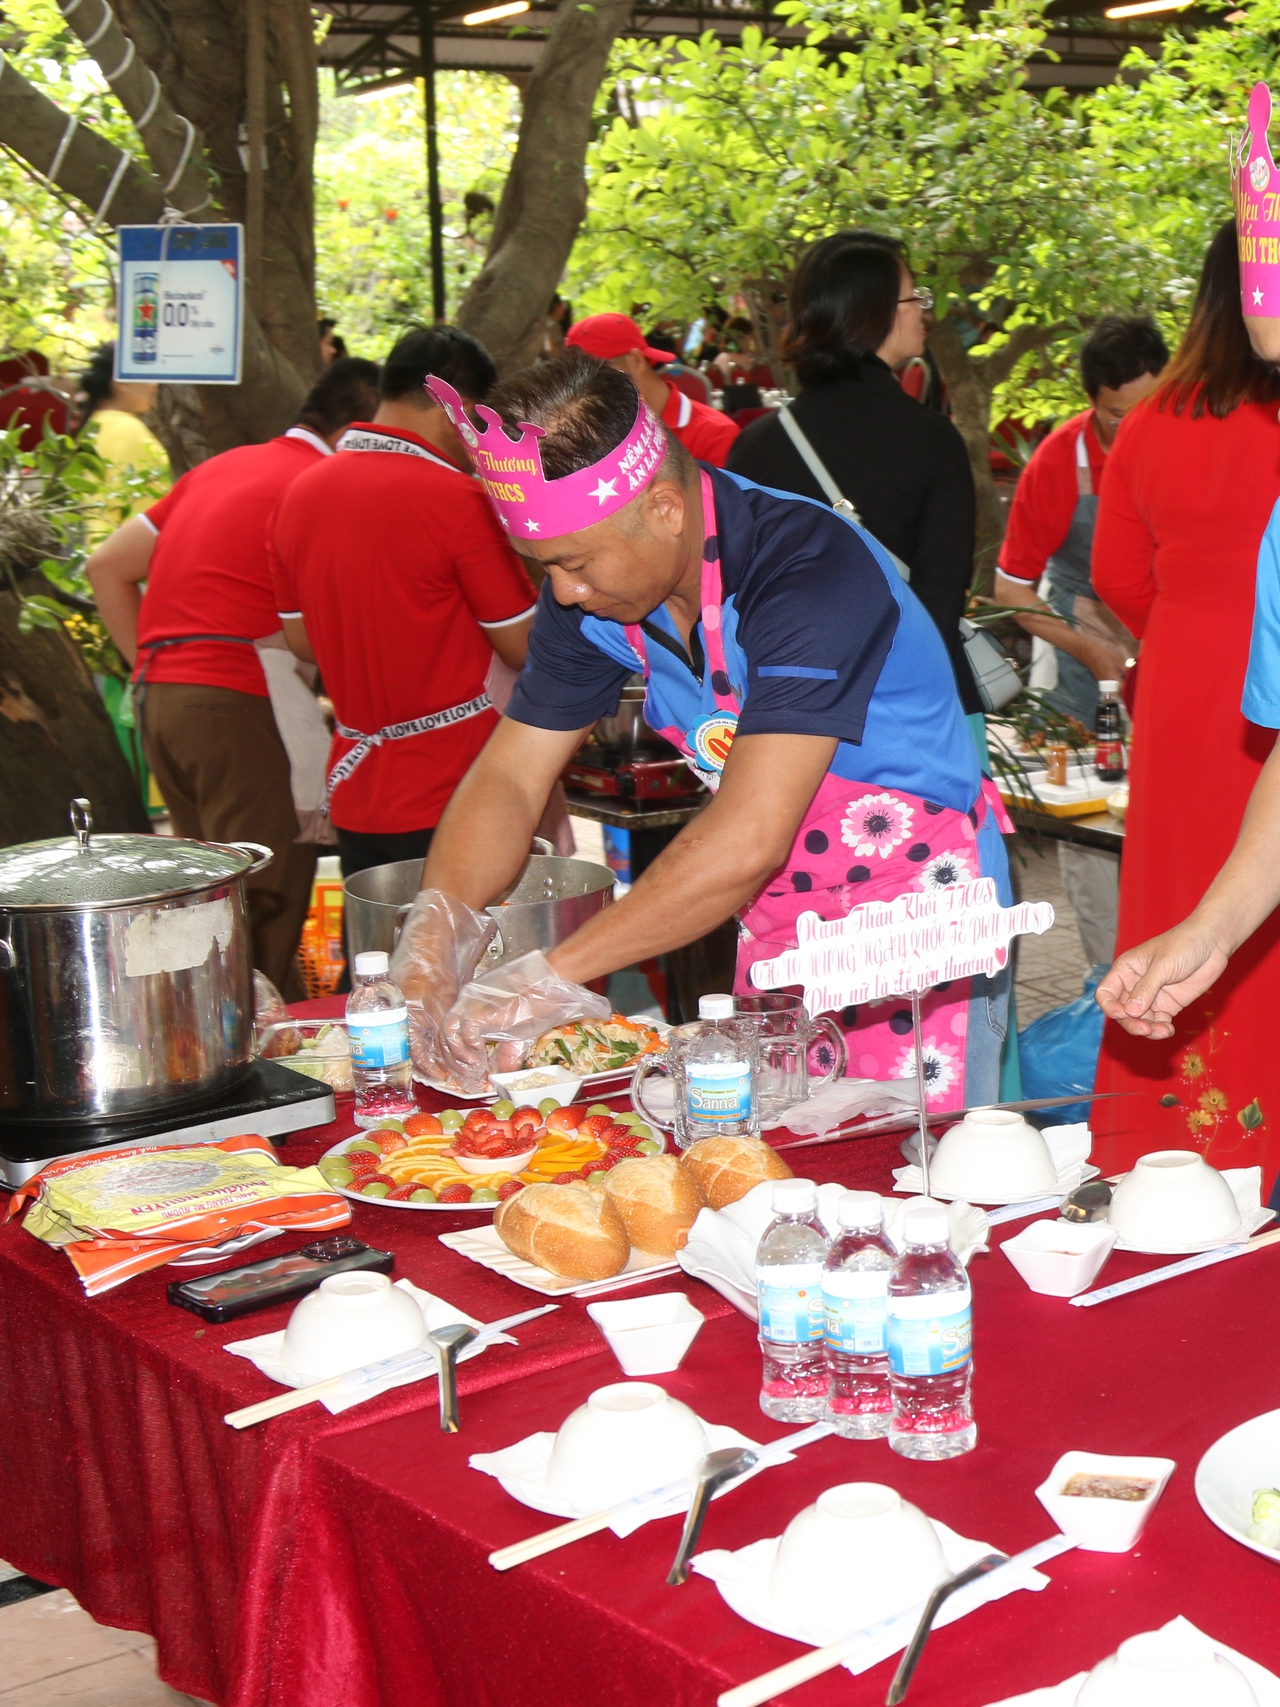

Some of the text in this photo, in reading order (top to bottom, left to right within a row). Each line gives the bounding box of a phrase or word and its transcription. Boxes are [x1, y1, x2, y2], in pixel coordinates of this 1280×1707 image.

[479, 449, 538, 476] Thương
[618, 440, 643, 474] NẾM
[488, 480, 525, 502] THCS
[627, 464, 648, 491] ĂN
[390, 721, 418, 738] LOVE
[419, 711, 450, 730] LOVE
[450, 700, 479, 721] LOVE
[800, 916, 845, 942] Nam
[943, 881, 995, 912] THCS
[1033, 905, 1052, 933] 8/3
[849, 982, 870, 1004] nữ
[875, 974, 889, 998] là
[945, 955, 994, 977] thương
[691, 1087, 739, 1110] Sanna
[941, 1325, 973, 1358] San
